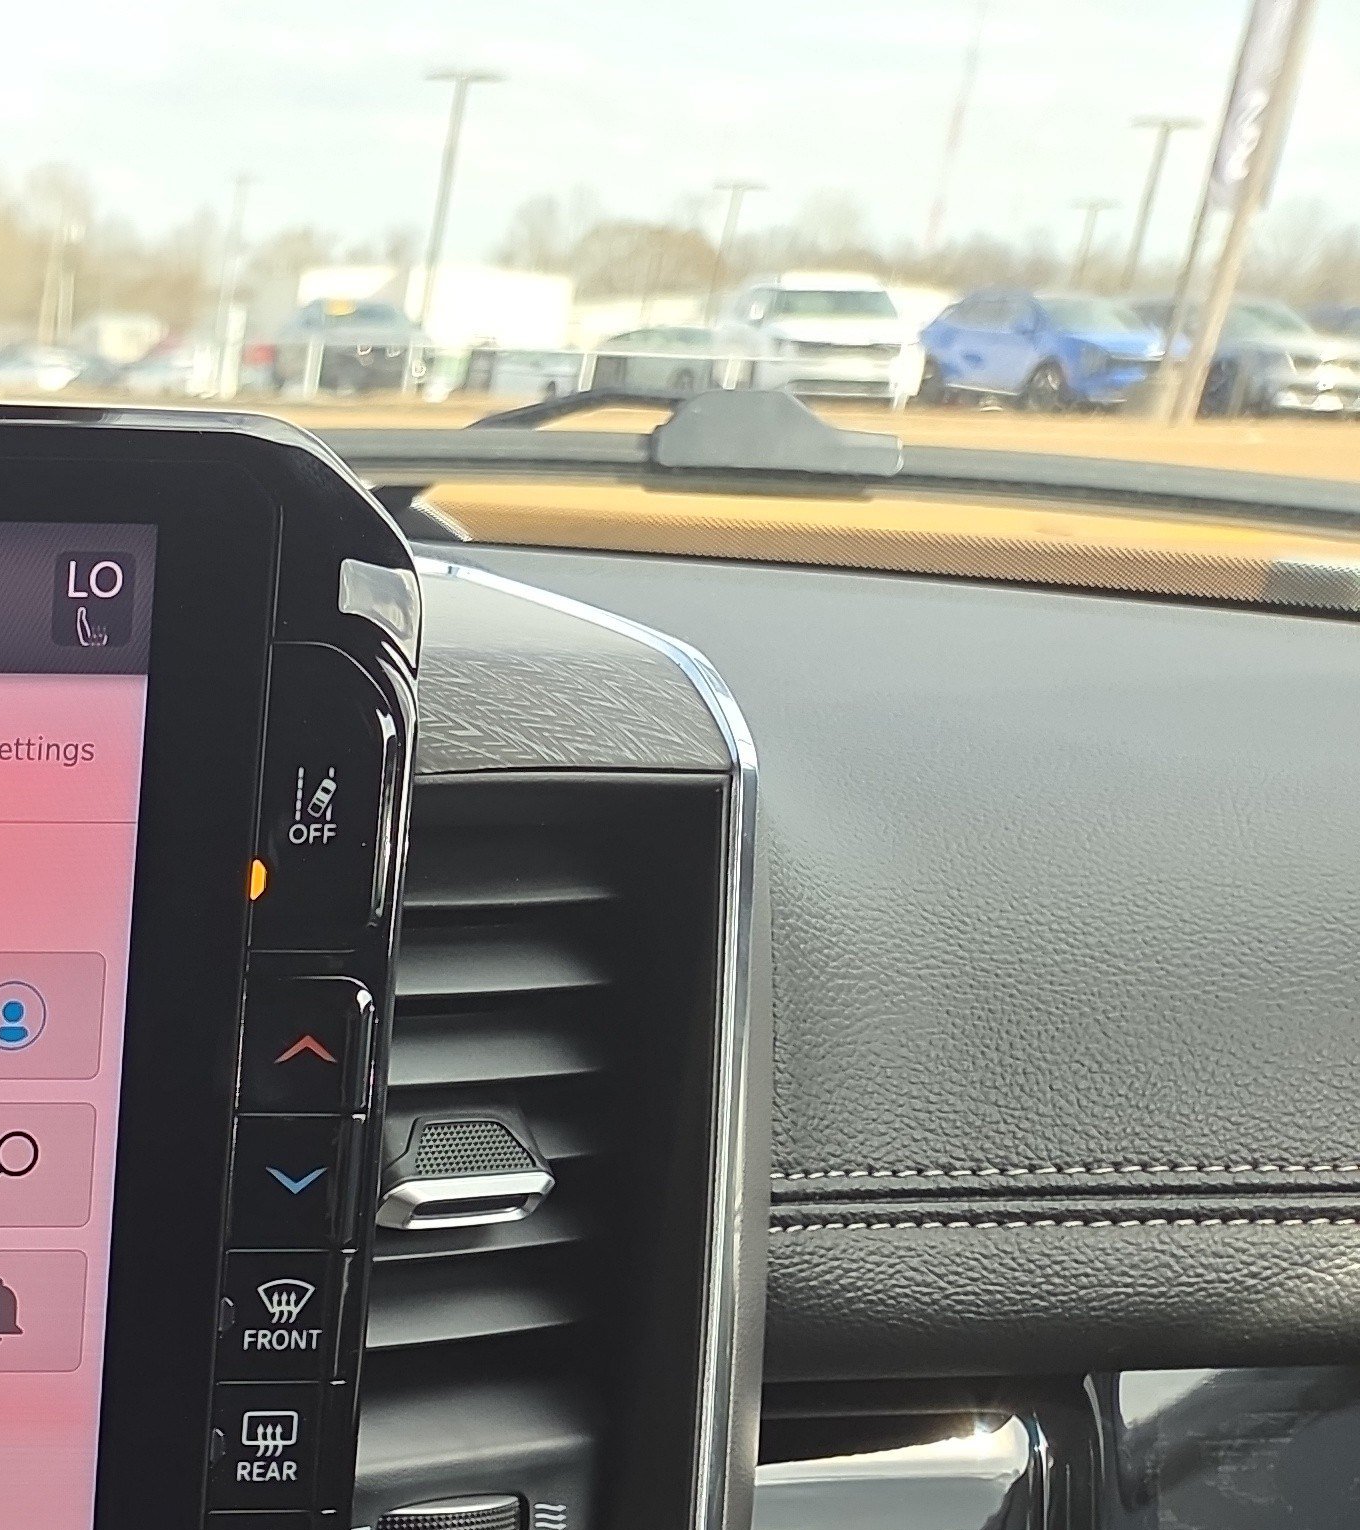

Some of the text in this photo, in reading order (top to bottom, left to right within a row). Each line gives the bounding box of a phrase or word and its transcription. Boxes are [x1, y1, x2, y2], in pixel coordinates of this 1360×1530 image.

[67, 561, 123, 599] LO
[289, 823, 337, 844] OFF
[243, 1328, 322, 1351] FRONT
[236, 1463, 296, 1482] REAR
